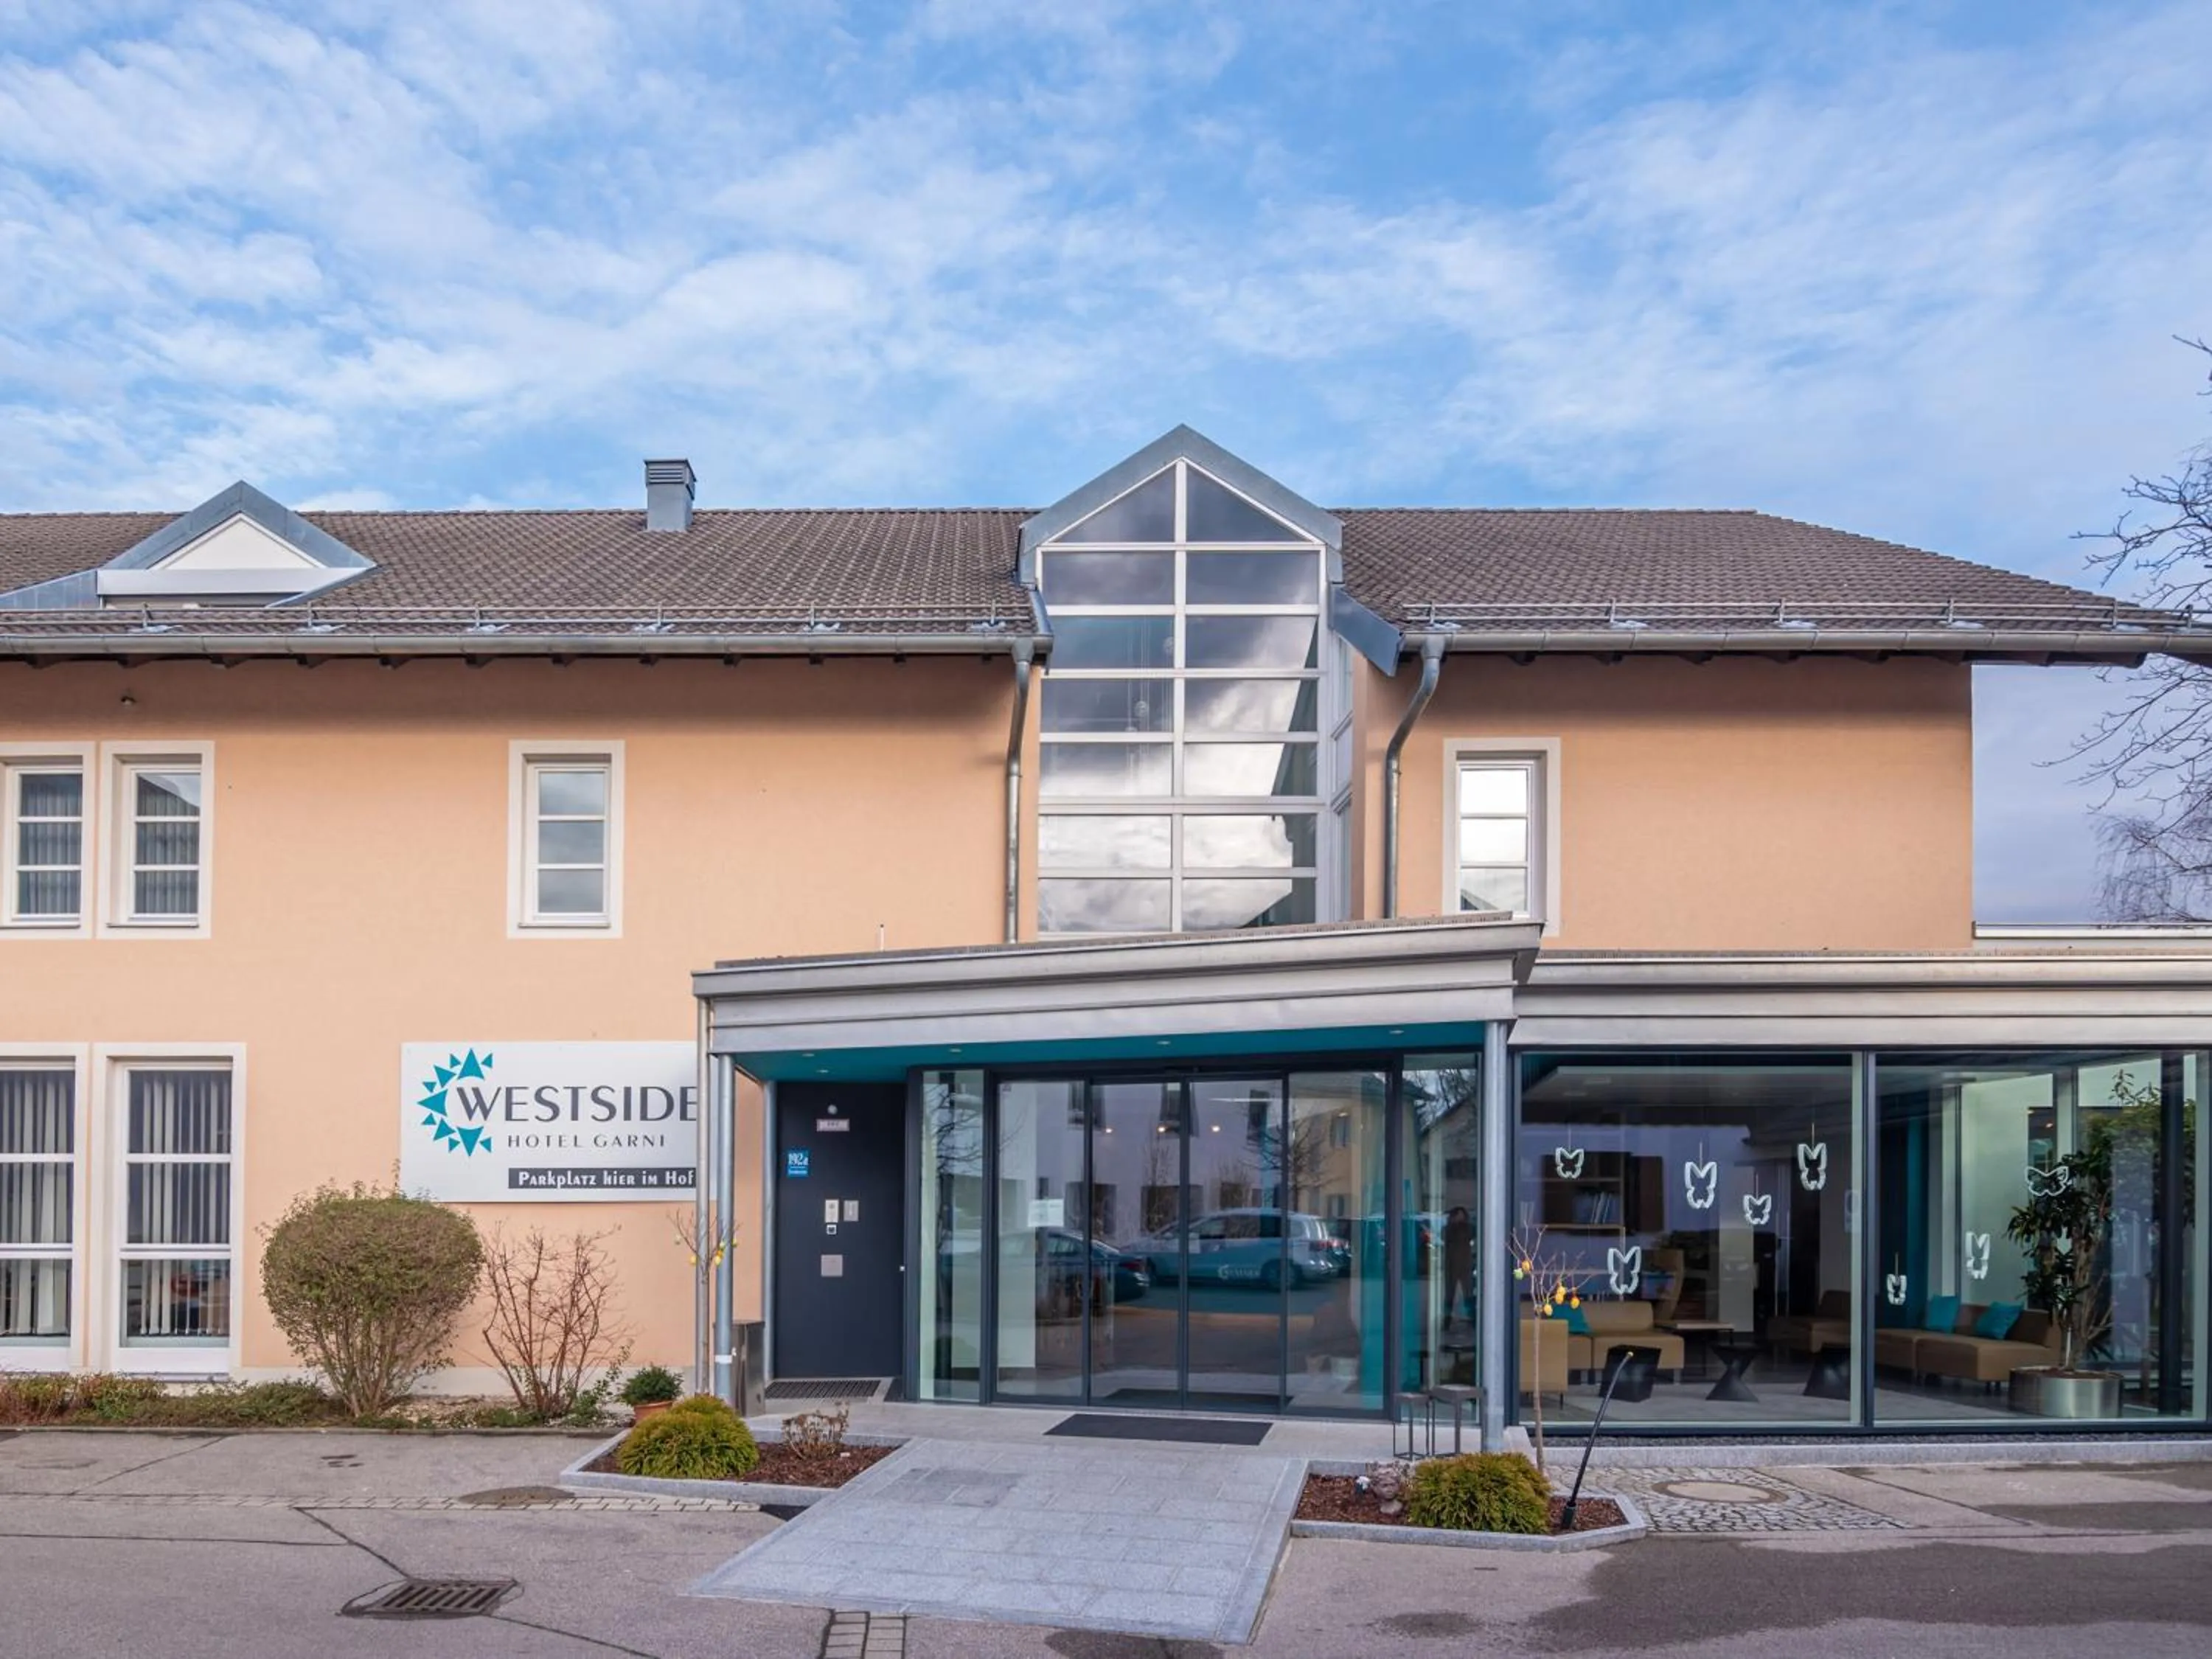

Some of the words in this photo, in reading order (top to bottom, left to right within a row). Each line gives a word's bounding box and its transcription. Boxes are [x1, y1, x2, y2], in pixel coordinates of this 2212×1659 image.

[456, 1085, 696, 1122] WESTSIDE
[508, 1134, 582, 1147] HOTEL
[594, 1134, 664, 1147] GARNI
[518, 1170, 597, 1189] Parkplatz
[603, 1170, 636, 1186] hier
[642, 1170, 658, 1186] im
[665, 1170, 694, 1186] Hof
